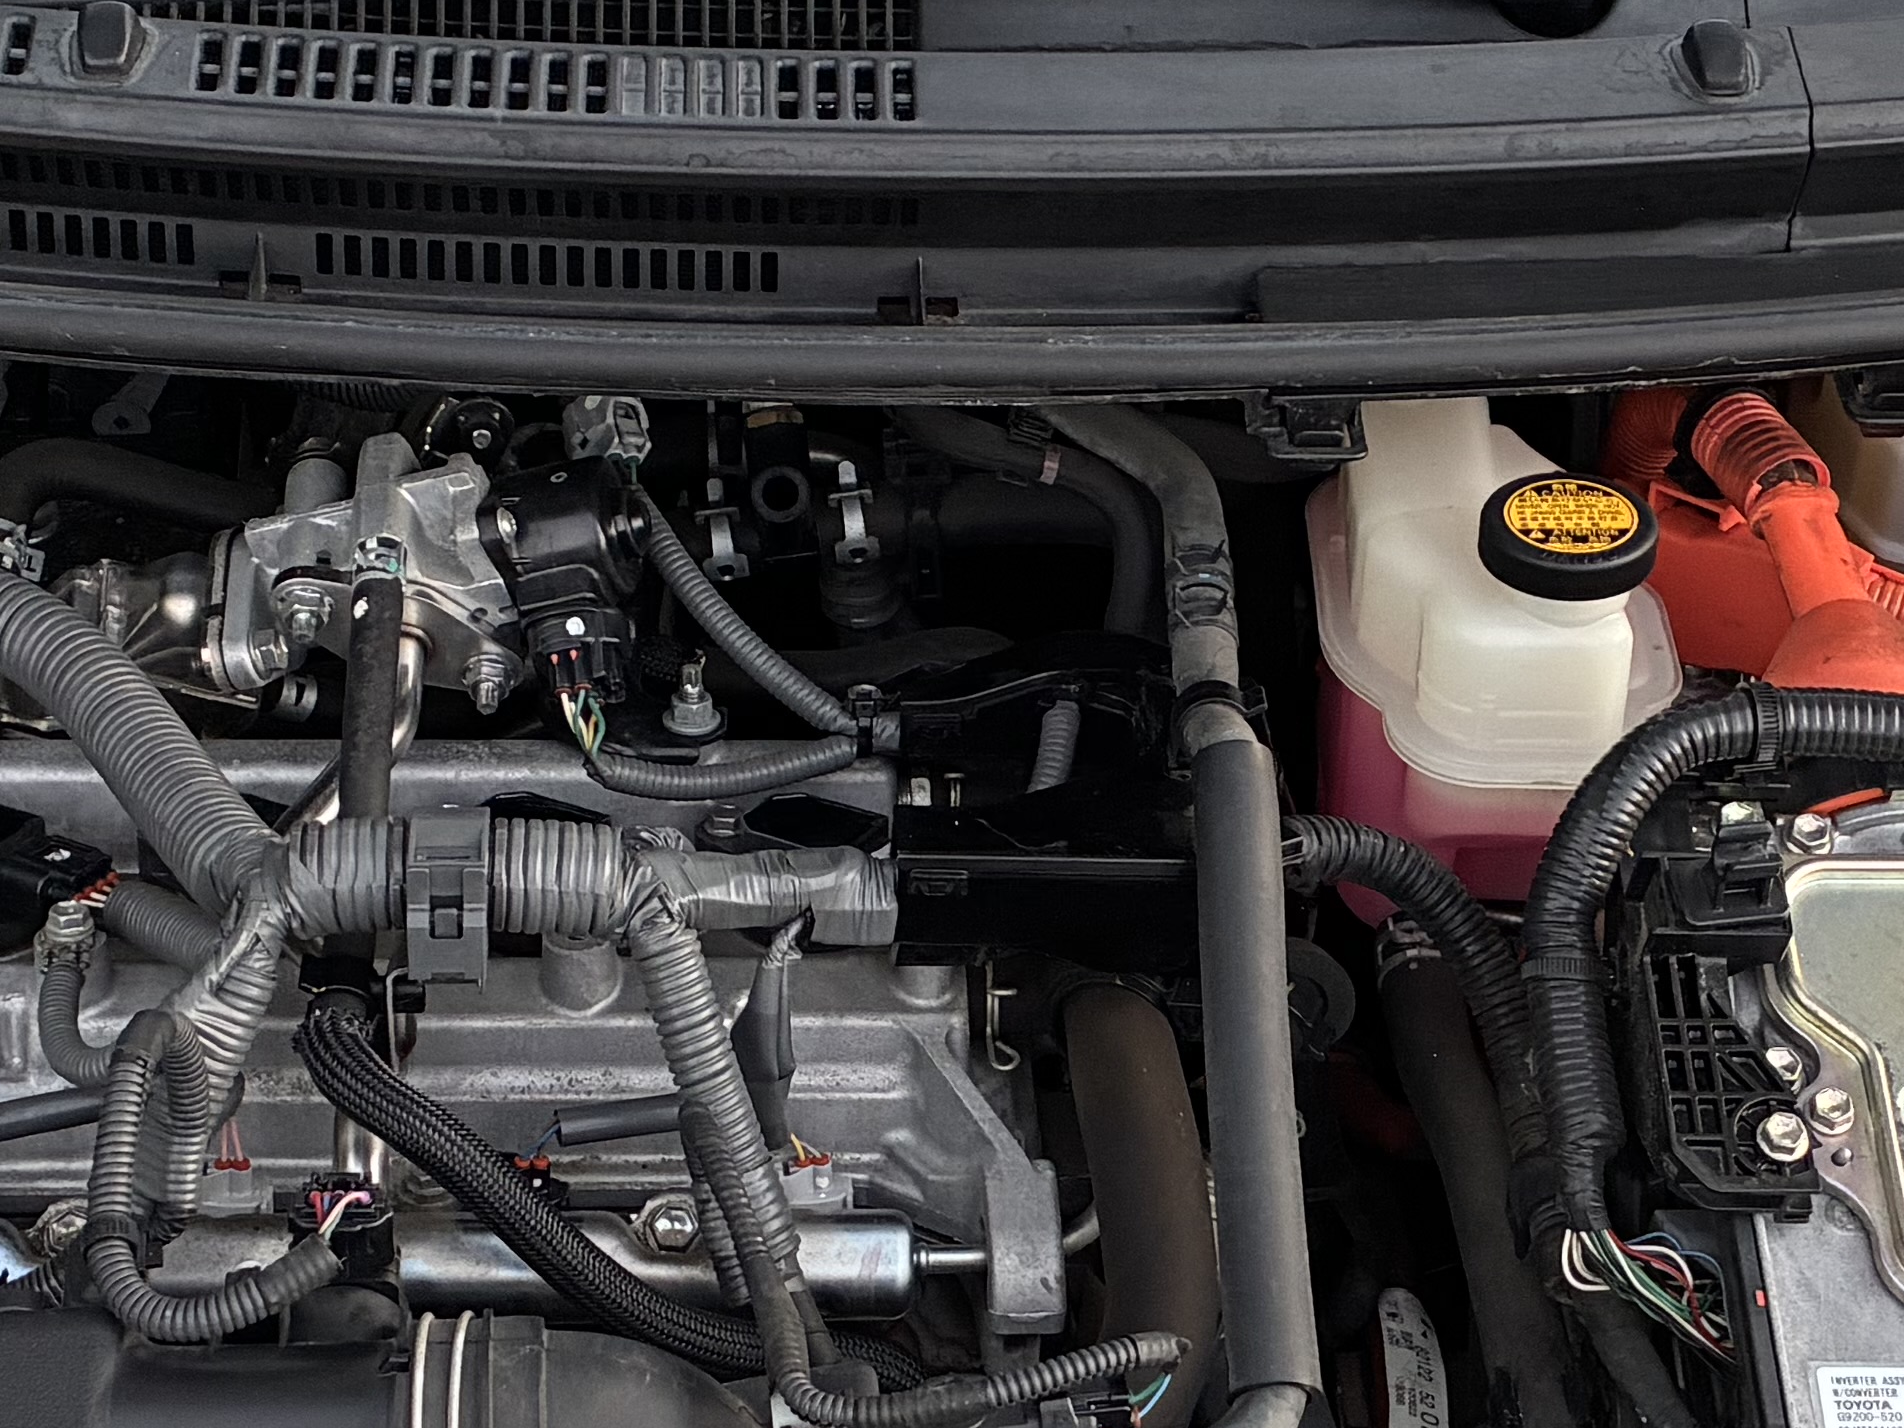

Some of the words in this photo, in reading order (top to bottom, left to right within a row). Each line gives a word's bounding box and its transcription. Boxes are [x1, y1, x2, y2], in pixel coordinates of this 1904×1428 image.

[1541, 489, 1603, 498] CAUTION
[1553, 529, 1619, 537] ATTENTION
[1830, 1375, 1877, 1386] INVERTER
[1834, 1400, 1893, 1410] TOYOTA
